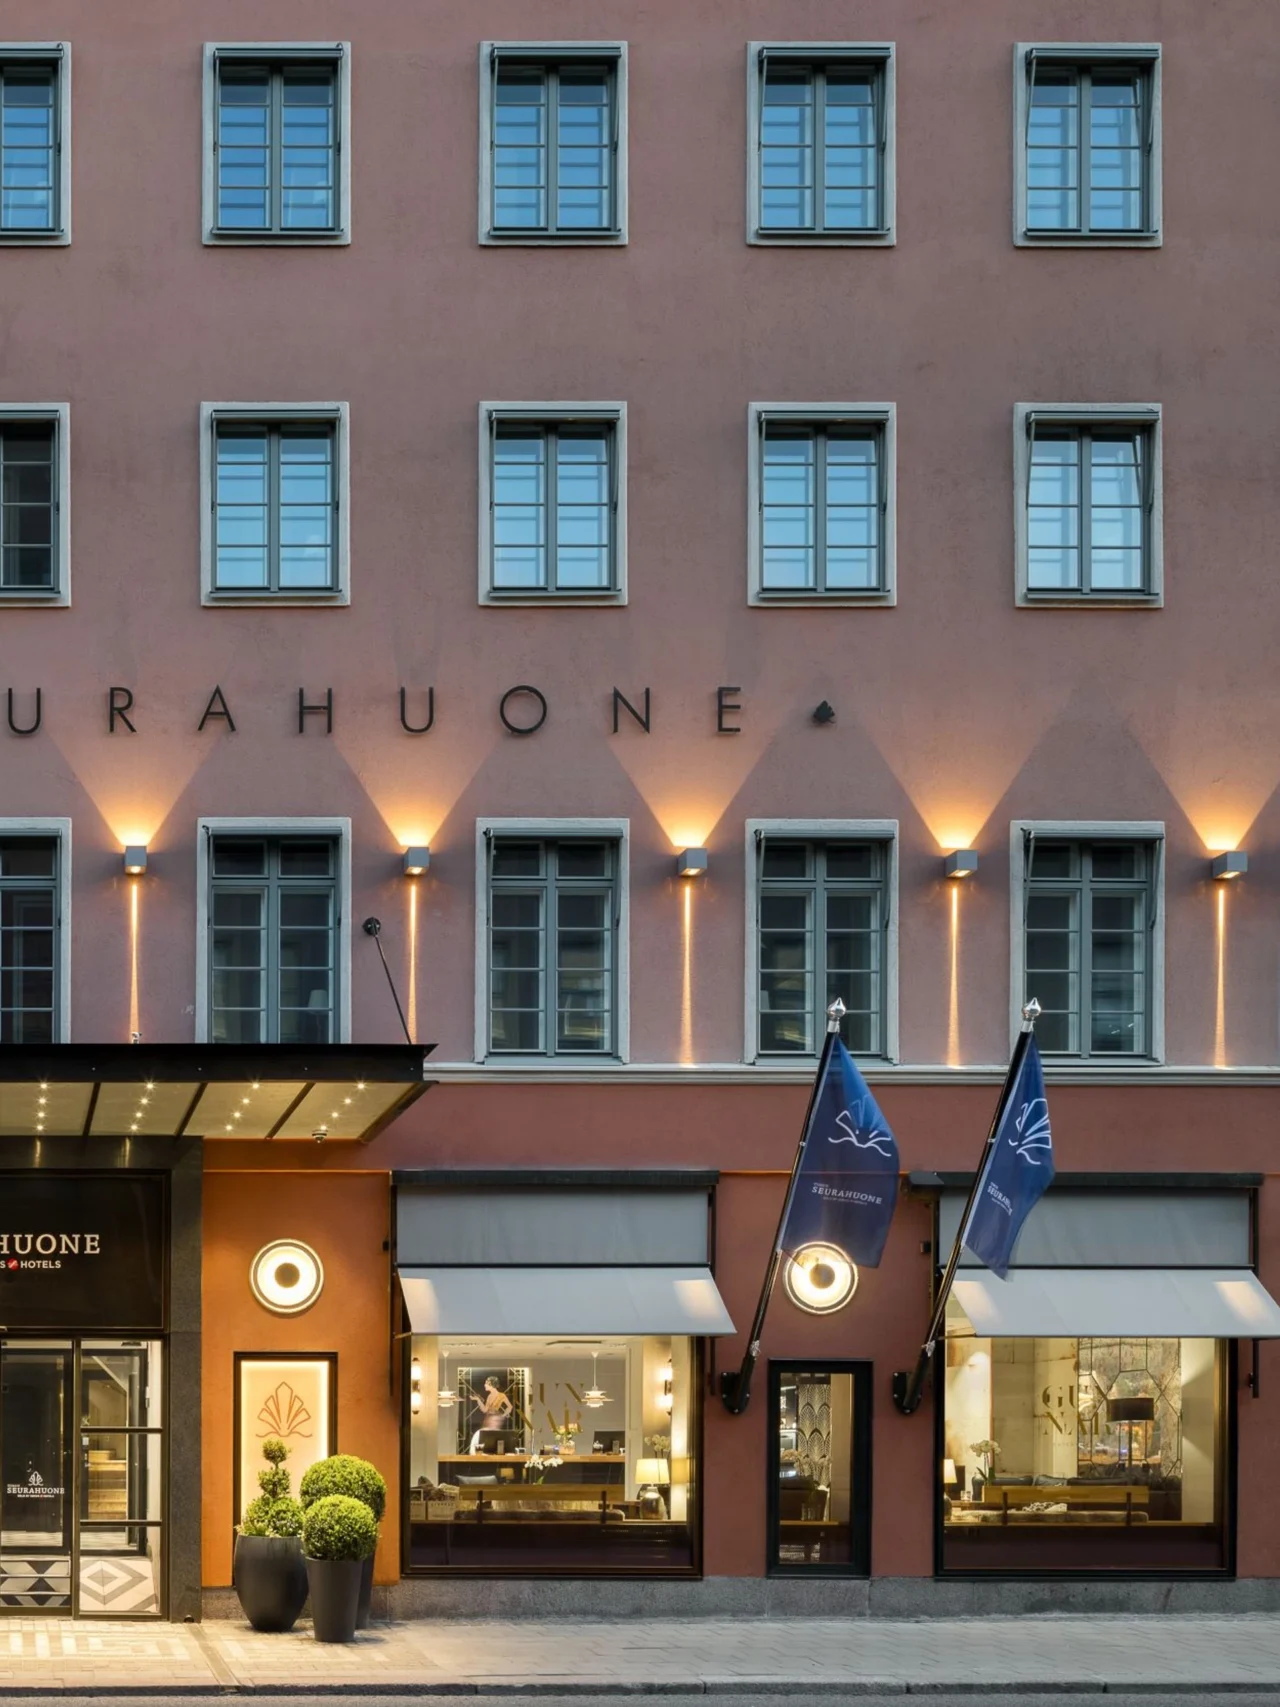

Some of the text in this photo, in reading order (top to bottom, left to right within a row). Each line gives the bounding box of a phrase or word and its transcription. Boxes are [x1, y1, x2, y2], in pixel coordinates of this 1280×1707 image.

[811, 1186, 883, 1205] SEURAHUONE
[20, 1260, 62, 1269] HOTELS
[7, 1487, 64, 1495] SEURAHUONE
